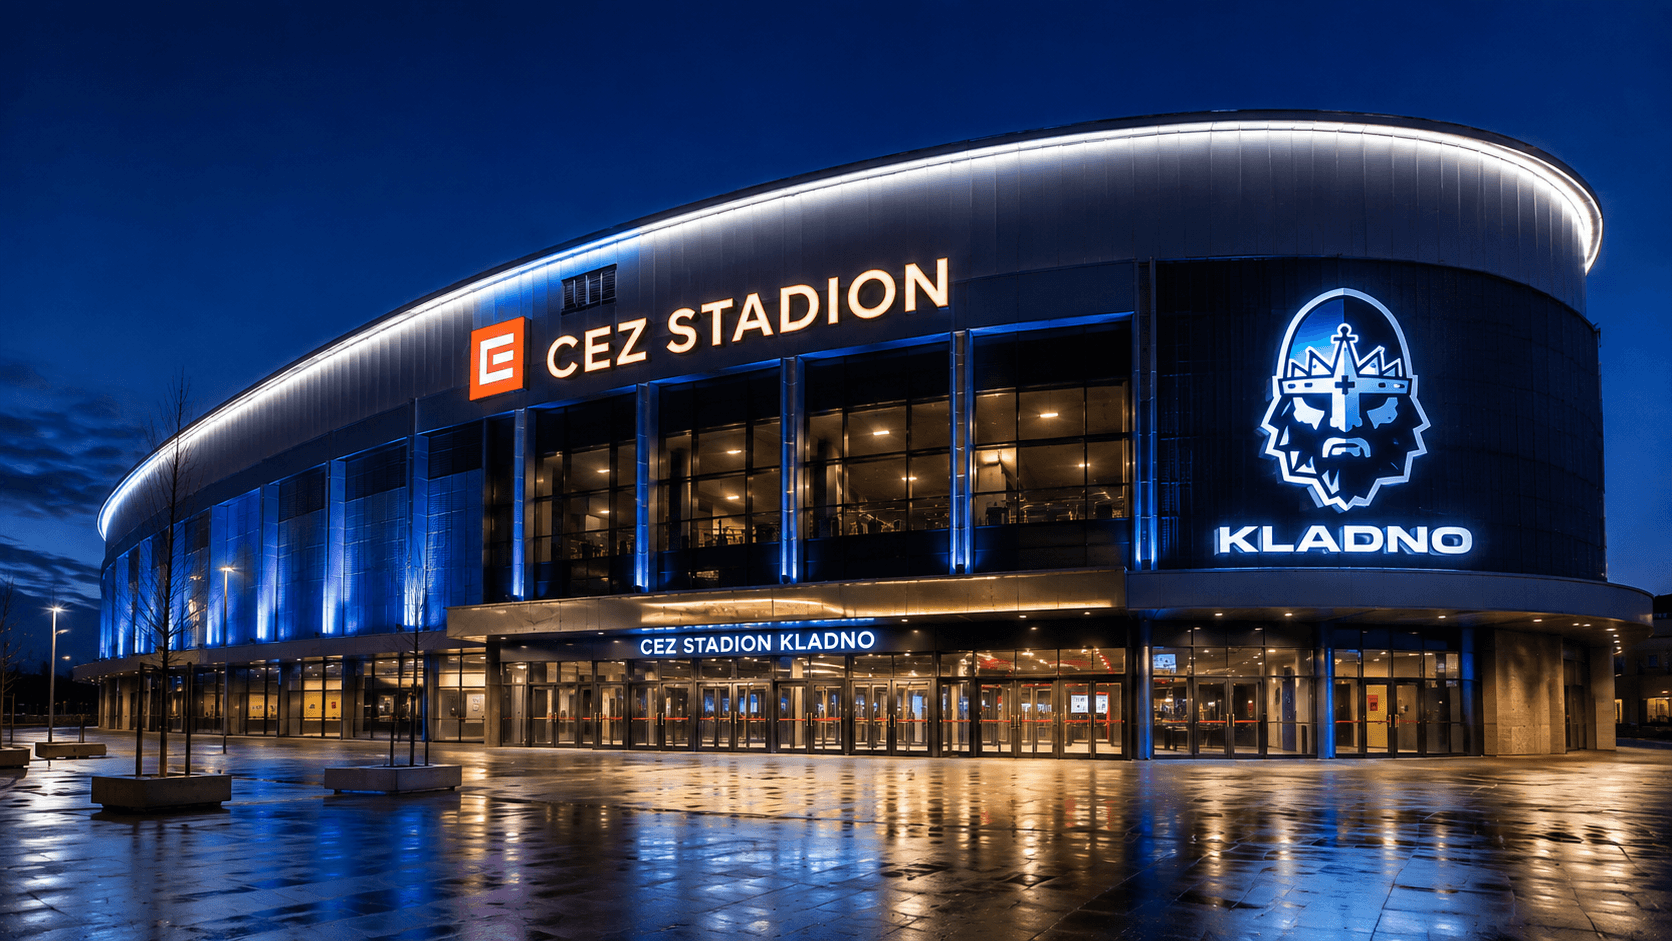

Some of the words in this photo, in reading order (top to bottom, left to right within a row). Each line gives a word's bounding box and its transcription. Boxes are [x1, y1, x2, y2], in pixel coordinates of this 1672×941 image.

[546, 317, 648, 378] CEZ
[666, 257, 950, 354] STADION
[1214, 524, 1473, 555] KLADNO
[640, 638, 676, 655] CEZ
[683, 634, 772, 653] STADION
[780, 630, 876, 651] KLADNO
